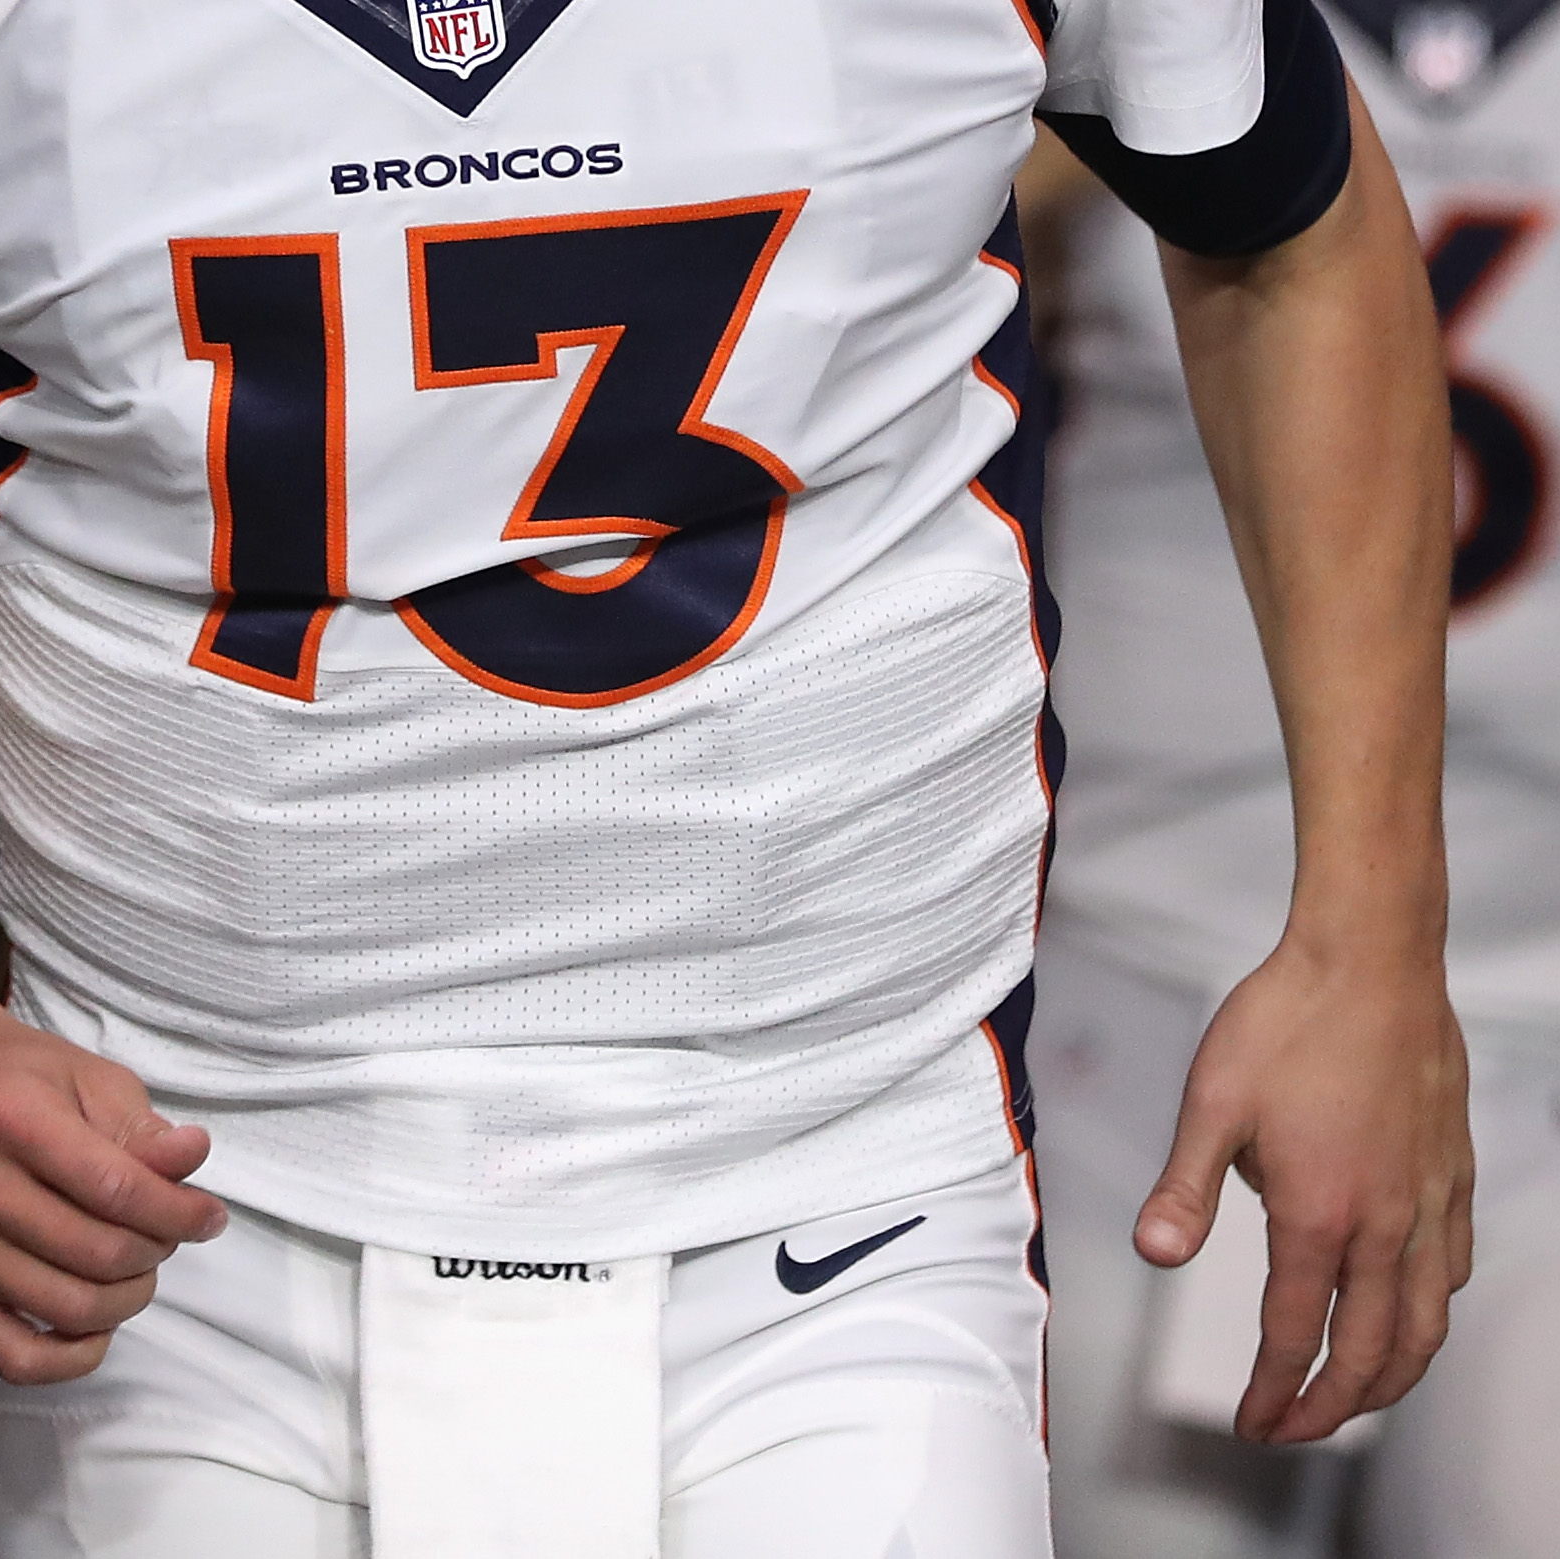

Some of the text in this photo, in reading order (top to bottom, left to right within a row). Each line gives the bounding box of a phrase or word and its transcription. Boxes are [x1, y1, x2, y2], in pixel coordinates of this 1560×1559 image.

[425, 10, 491, 57] NFL
[330, 142, 624, 196] BRONCOS
[168, 188, 811, 710] 13
